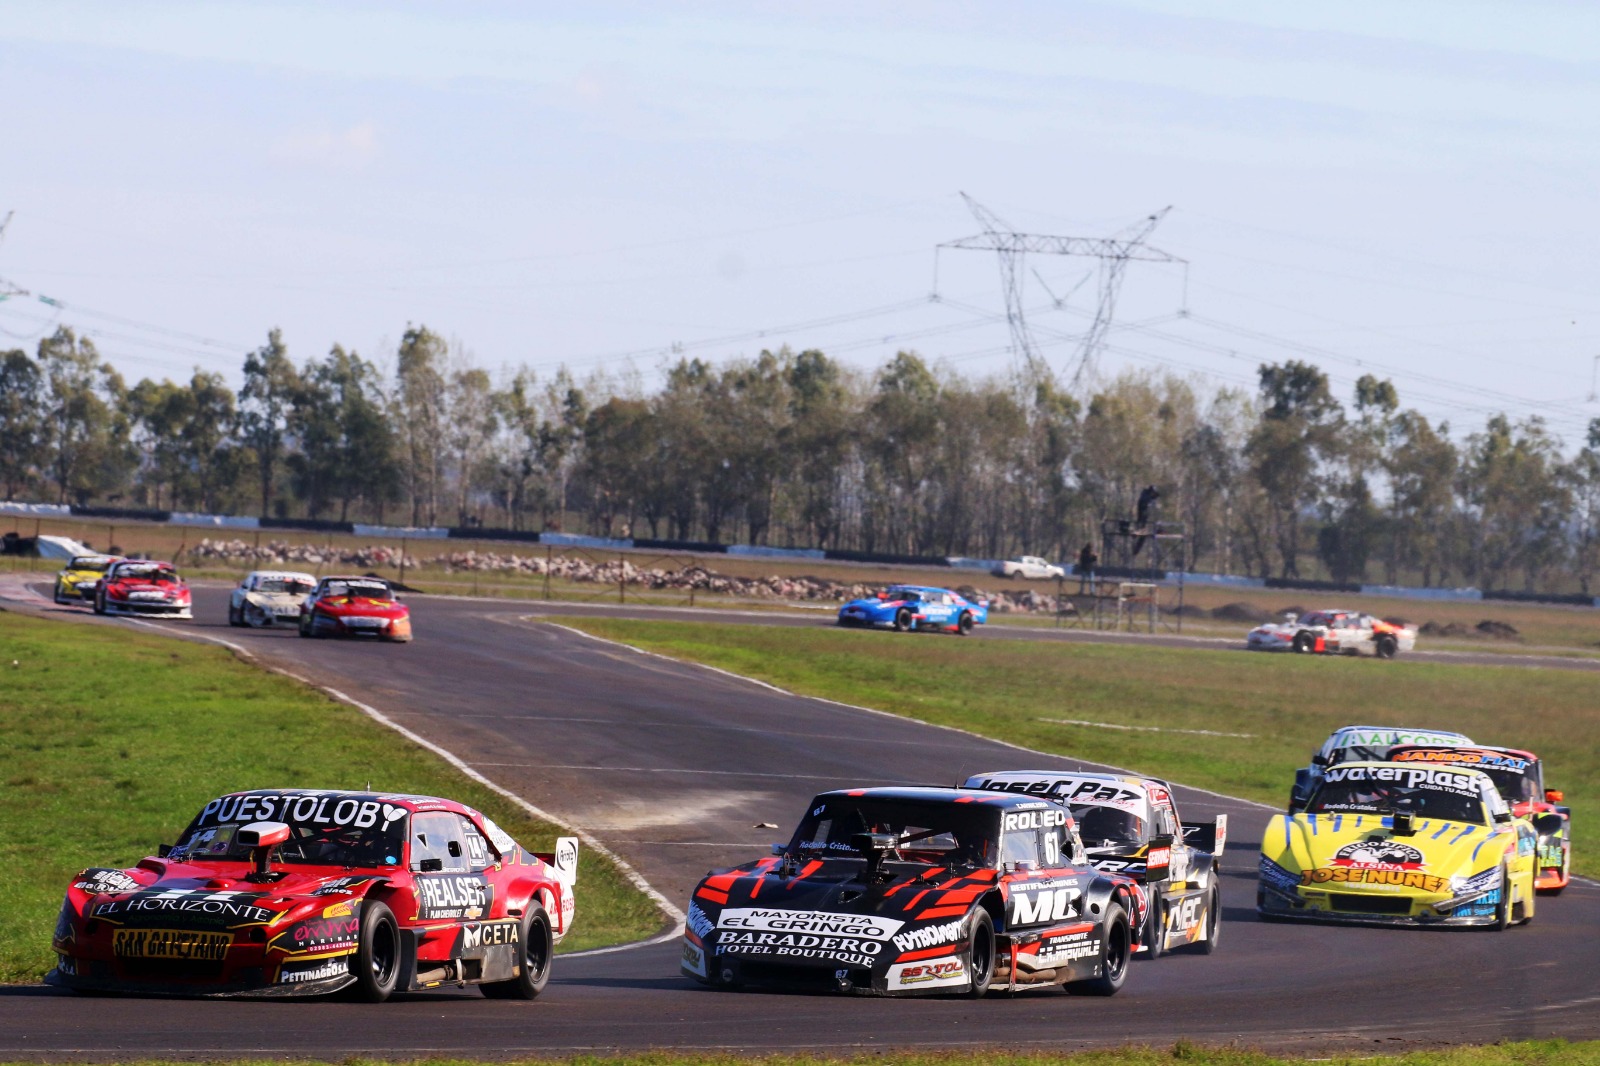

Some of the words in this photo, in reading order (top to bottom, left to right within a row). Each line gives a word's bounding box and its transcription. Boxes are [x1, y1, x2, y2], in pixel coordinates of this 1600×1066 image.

[1325, 766, 1481, 793] waterplast
[1419, 783, 1443, 791] CUIDA
[1455, 789, 1478, 798] AGUA
[813, 805, 826, 816] 67
[1044, 831, 1060, 865] 67
[96, 902, 119, 915] EL
[126, 899, 271, 922] HORIZONTE
[750, 910, 873, 925] MAYORISTA
[294, 917, 359, 941] emma
[482, 923, 519, 945] CETA
[722, 917, 755, 927] EL
[767, 919, 885, 937] GRINGO
[115, 931, 147, 957] SAN
[717, 932, 882, 955] BARADERO
[715, 945, 772, 956] HOTEL
[776, 947, 875, 969] BOUTIQUE
